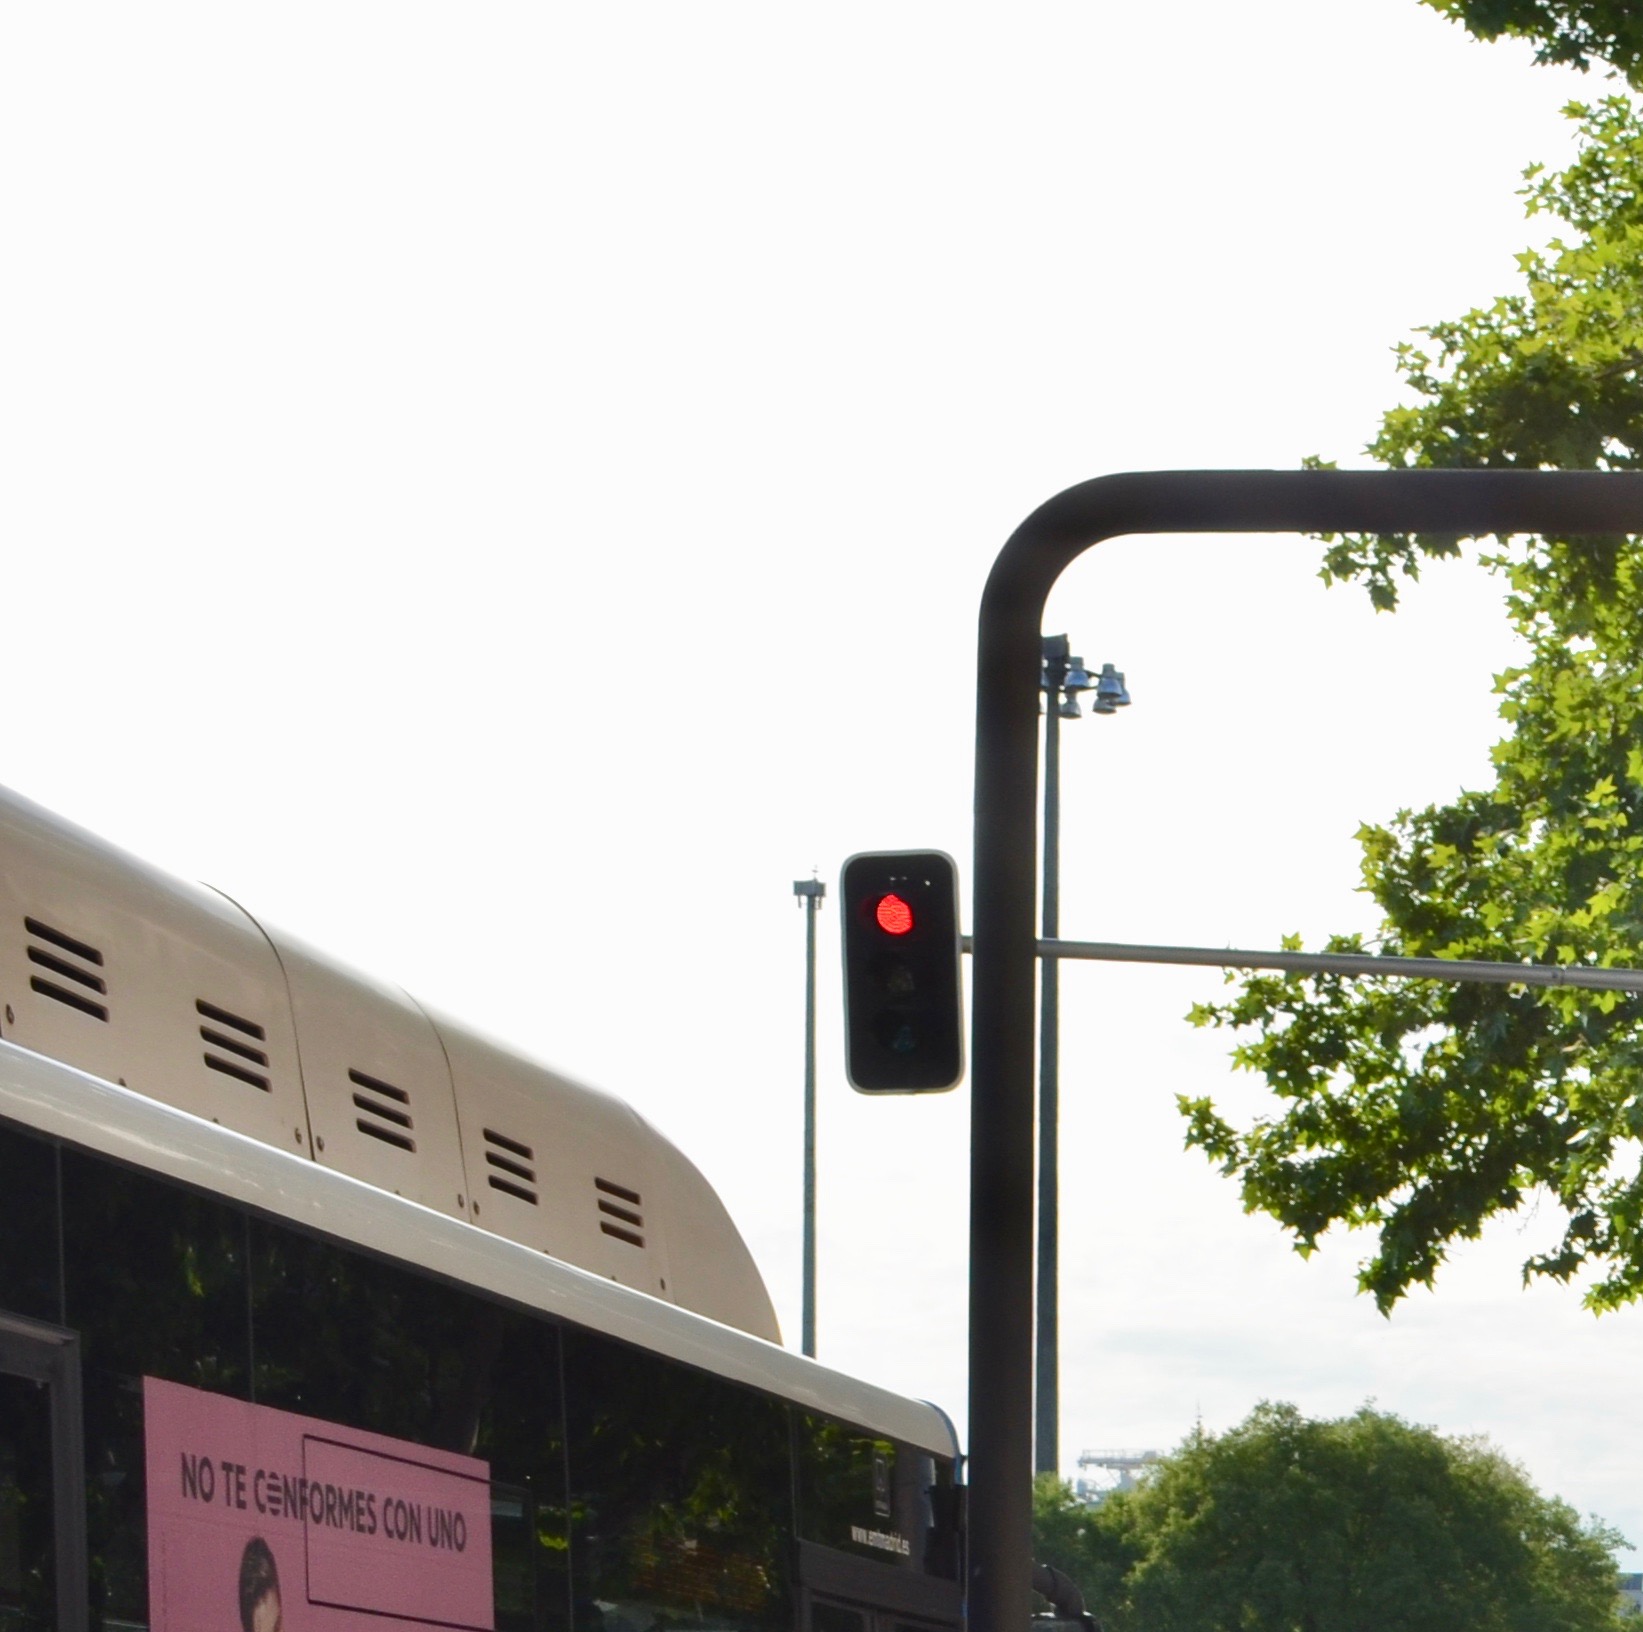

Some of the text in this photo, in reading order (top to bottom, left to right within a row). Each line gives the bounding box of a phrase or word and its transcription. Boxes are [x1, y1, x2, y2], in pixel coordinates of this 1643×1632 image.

[181, 1452, 467, 1552] NO TE CONFORMES CON UNO
